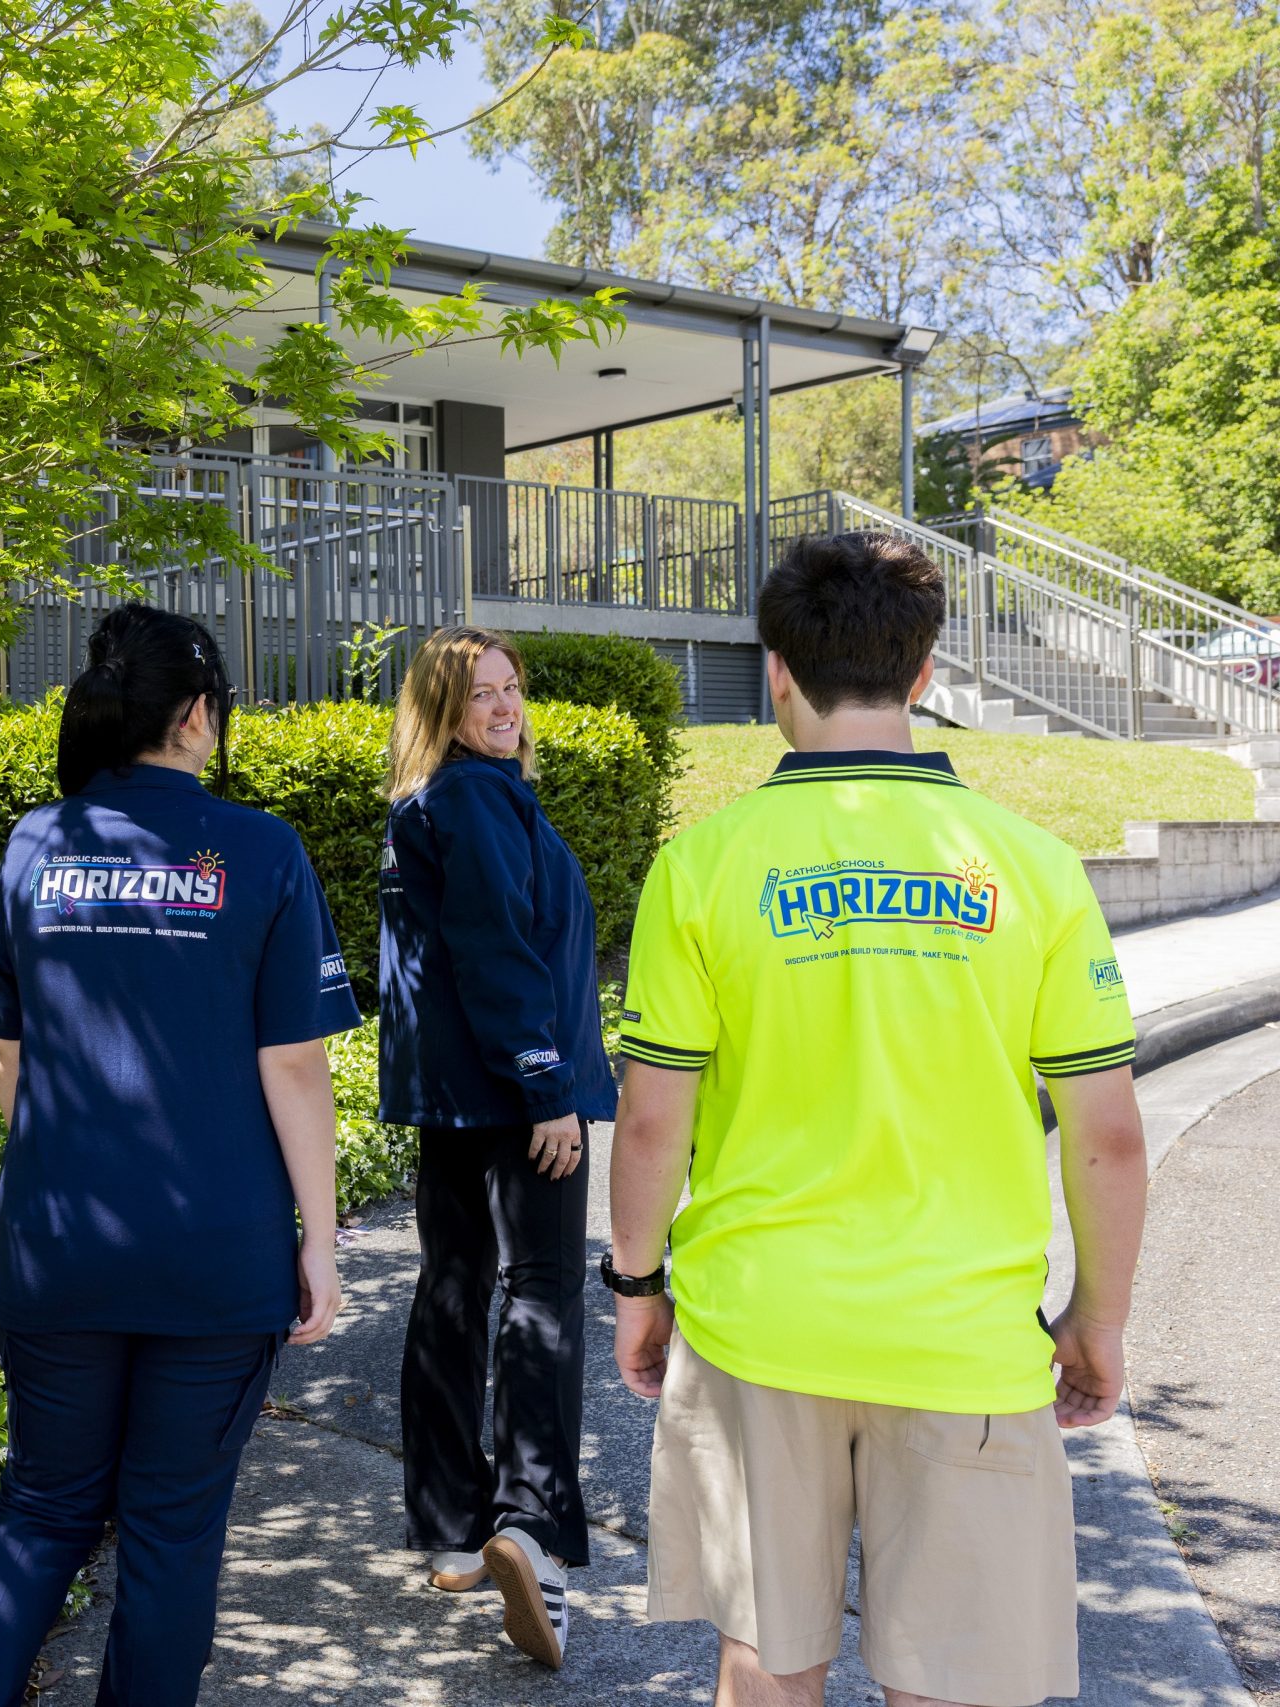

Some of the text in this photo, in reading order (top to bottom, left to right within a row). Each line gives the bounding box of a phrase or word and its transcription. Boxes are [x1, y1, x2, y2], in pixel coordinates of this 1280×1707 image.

[52, 855, 131, 864] CATHOLIC SCHOOLS
[785, 860, 885, 877] CATHOLIC SCHOOLS
[40, 868, 217, 904] HORIZONS
[777, 877, 989, 926] HORIZONS
[165, 908, 217, 919] Broken Bay
[128, 927, 152, 935] FUTURE.
[155, 928, 172, 936] MAKE
[172, 929, 188, 937] YOUR
[189, 931, 208, 939] MARK.
[965, 932, 988, 944] Bay
[785, 954, 819, 965] DISCOVER
[820, 950, 839, 960] YOUR
[850, 947, 871, 955] BUILD
[872, 947, 889, 955] YOUR
[889, 948, 919, 957] FUTURE.
[922, 951, 942, 959] MAKE
[943, 952, 960, 961] YOUR
